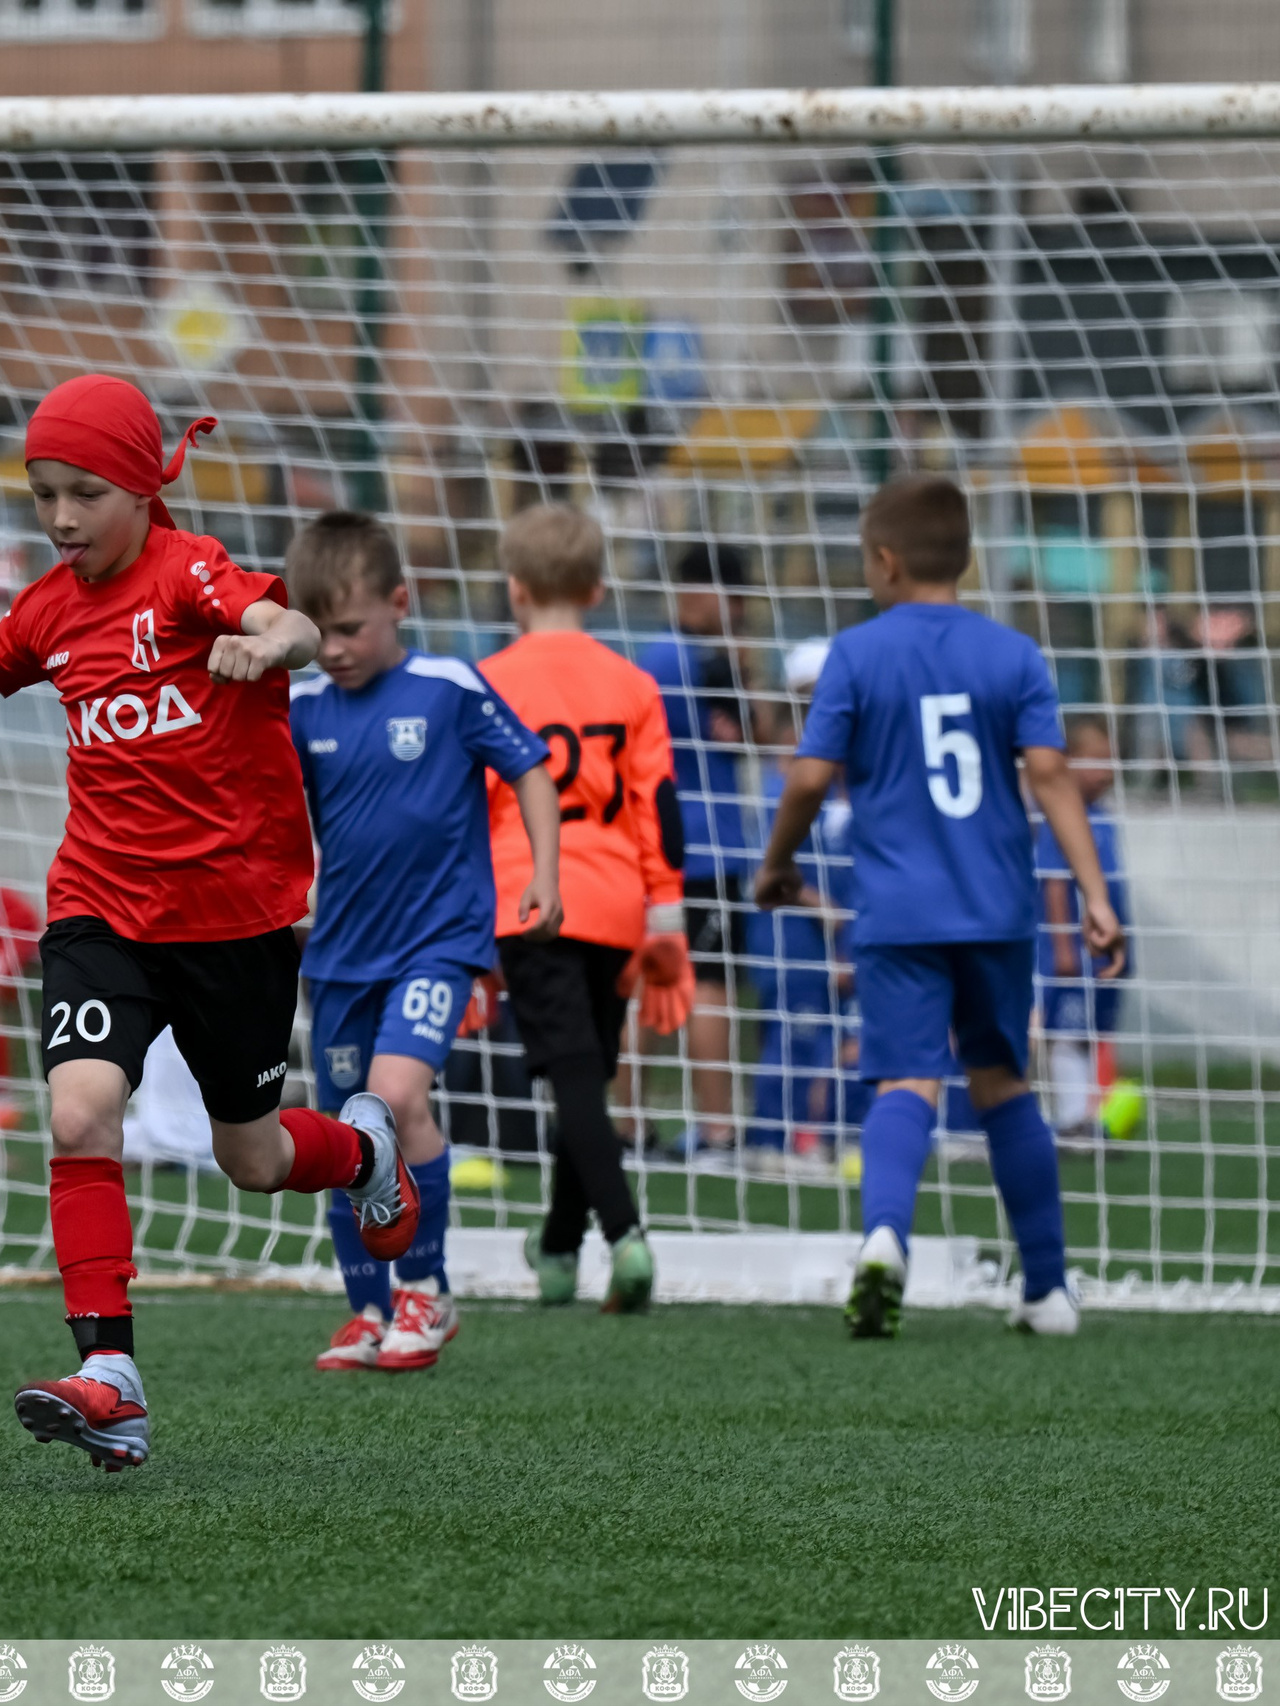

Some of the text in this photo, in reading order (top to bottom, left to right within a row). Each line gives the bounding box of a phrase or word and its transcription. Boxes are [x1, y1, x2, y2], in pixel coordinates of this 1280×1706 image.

[536, 722, 627, 824] 27
[920, 692, 982, 820] 5
[47, 998, 112, 1050] 20
[402, 977, 454, 1028] 69
[255, 1060, 288, 1088] JAKO
